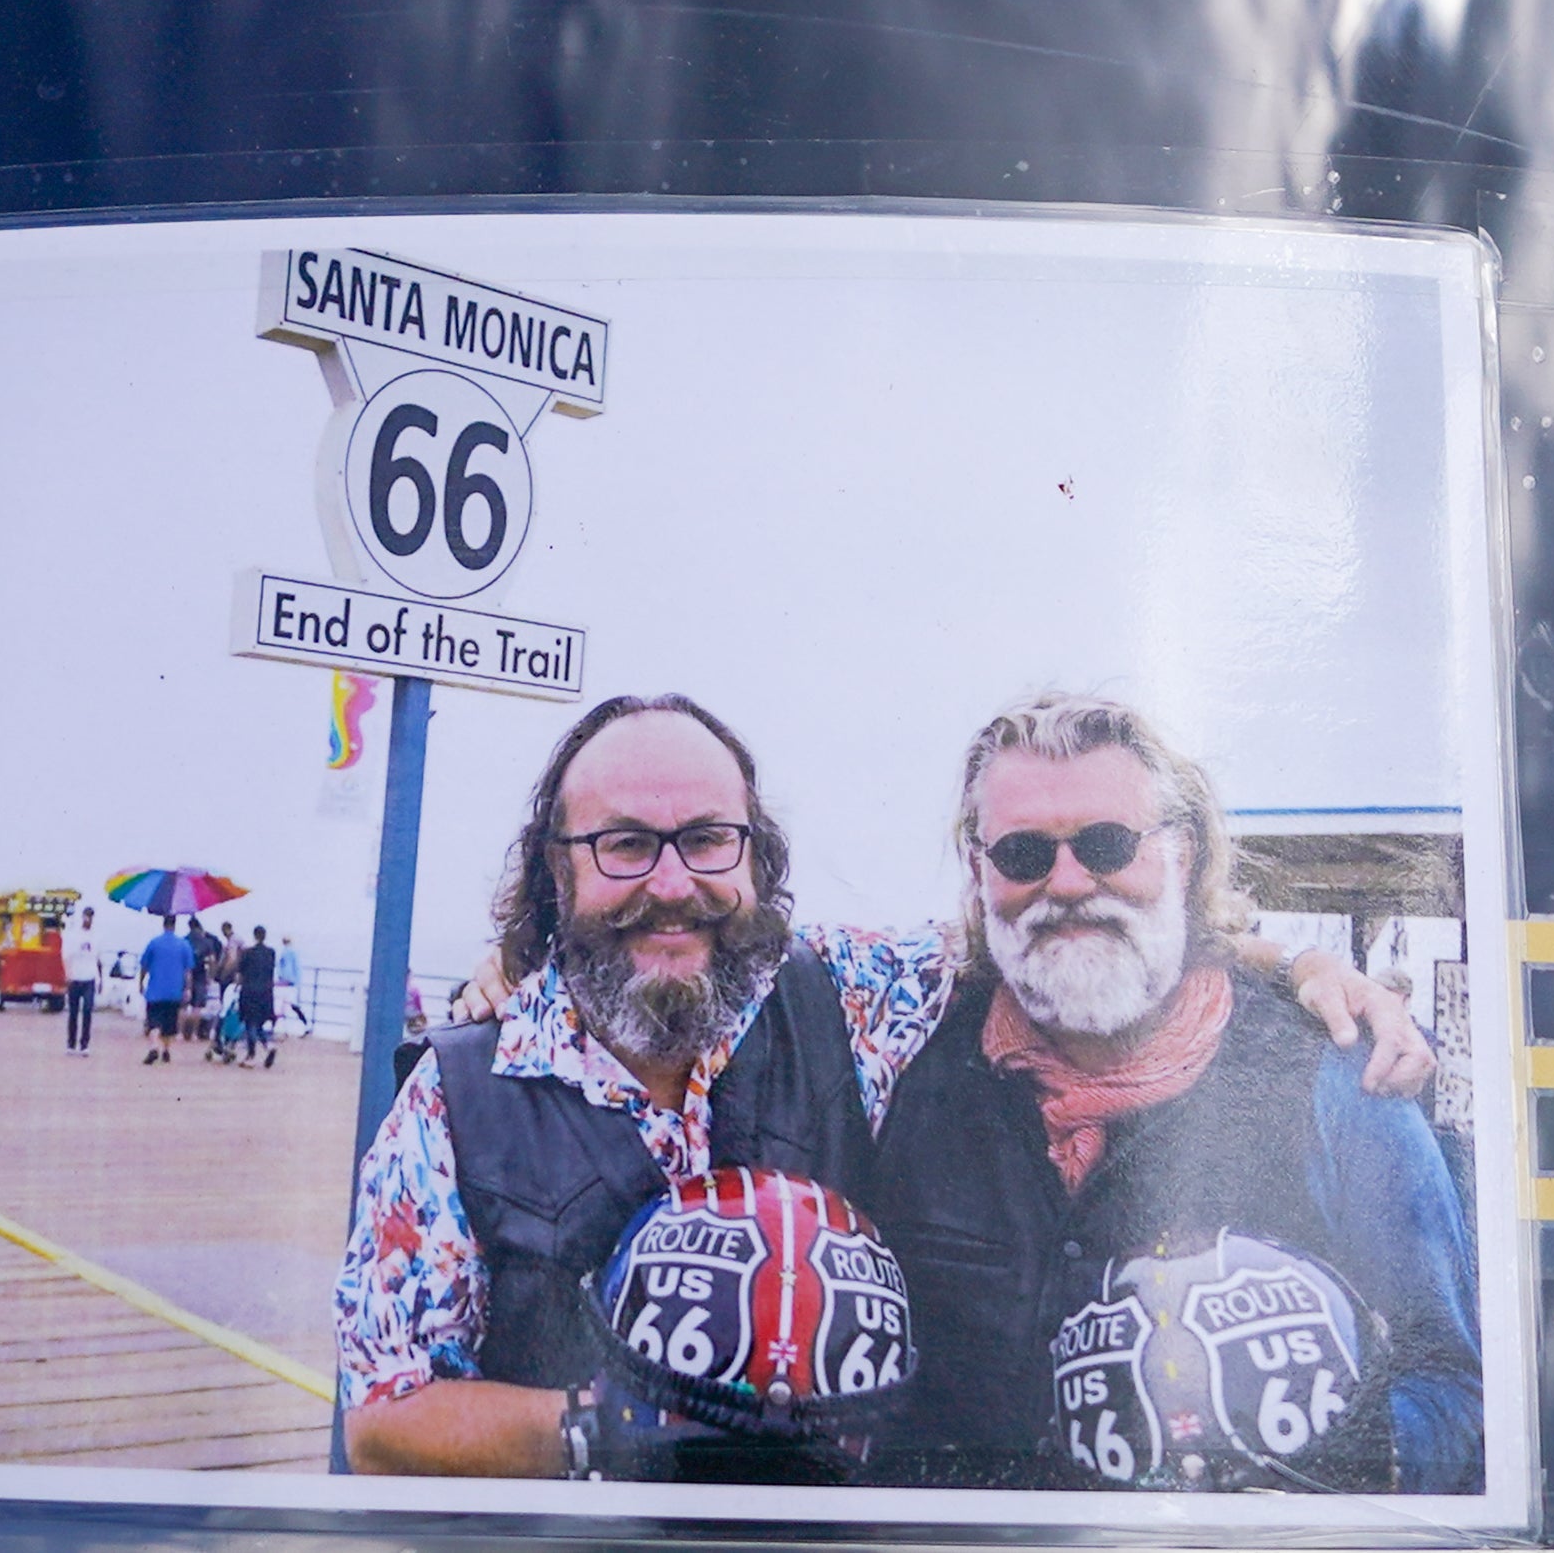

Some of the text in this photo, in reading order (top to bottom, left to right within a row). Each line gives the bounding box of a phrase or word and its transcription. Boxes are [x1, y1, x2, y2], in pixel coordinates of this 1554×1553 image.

[296, 251, 596, 386] SANTA MONICA
[369, 403, 510, 571] 66
[272, 592, 573, 683] End of the Trail
[642, 1223, 744, 1259] ROUTE
[647, 1266, 714, 1301] US
[831, 1248, 904, 1294] ROUTE
[855, 1296, 903, 1336] US
[1202, 1280, 1314, 1329] ROUTE
[627, 1301, 715, 1377] 66
[1247, 1329, 1323, 1372] US
[1063, 1369, 1109, 1411] US
